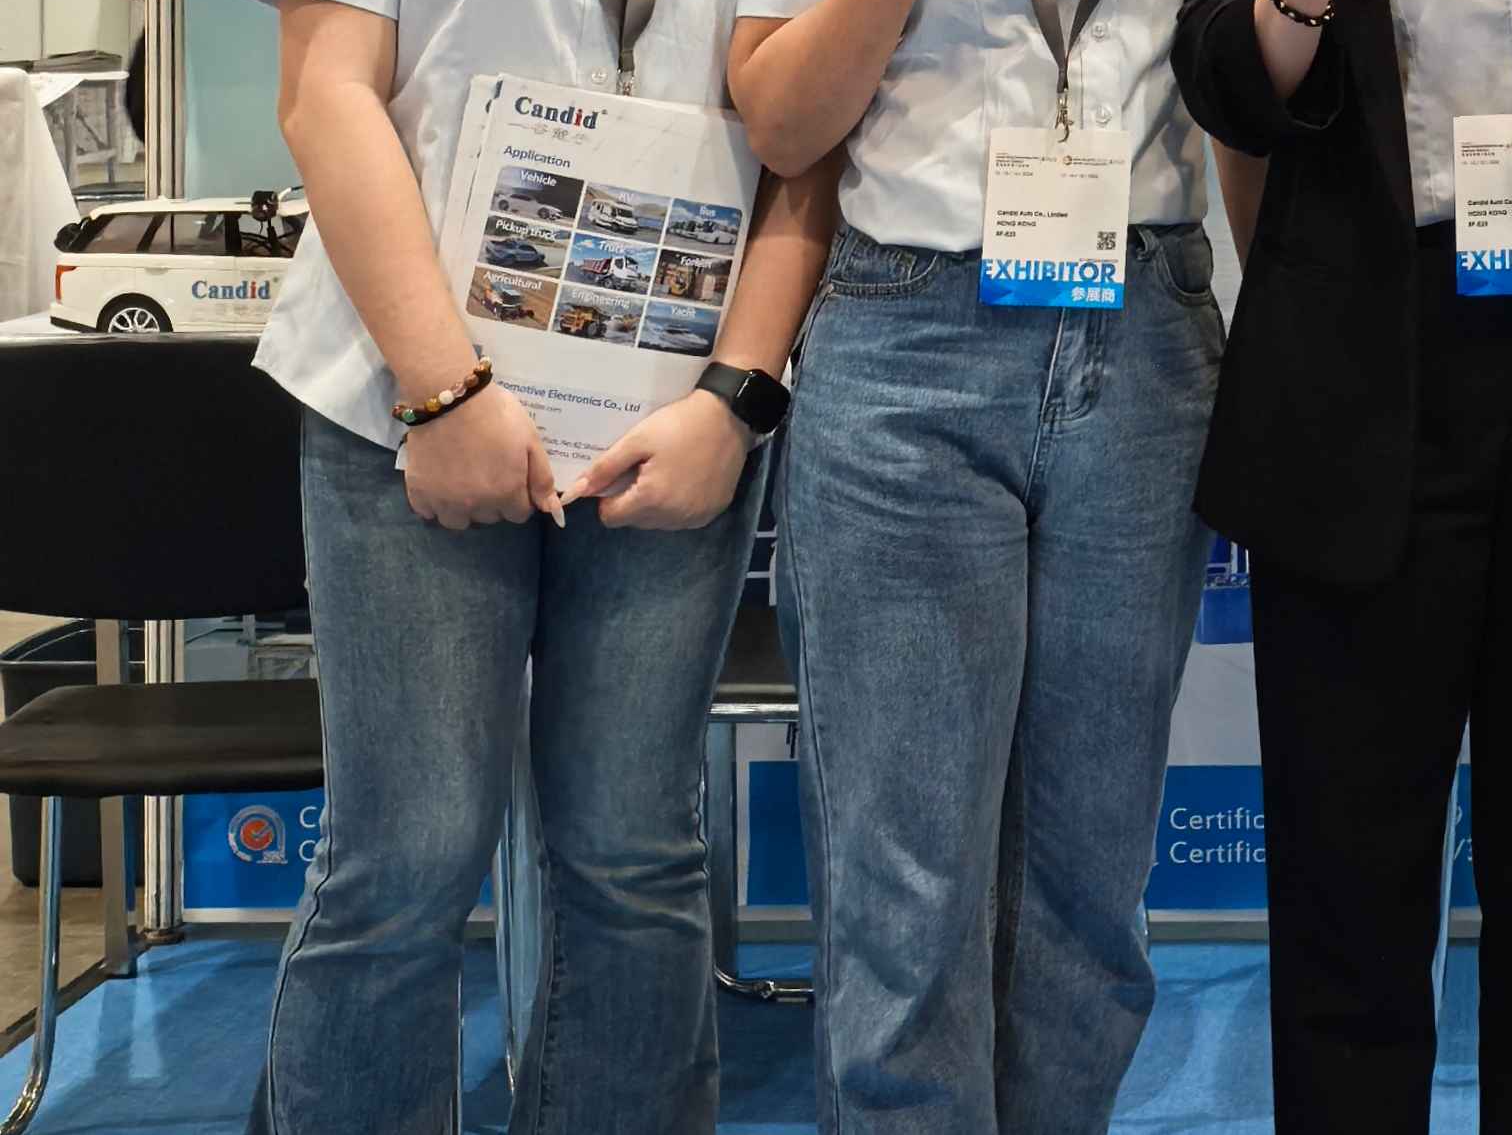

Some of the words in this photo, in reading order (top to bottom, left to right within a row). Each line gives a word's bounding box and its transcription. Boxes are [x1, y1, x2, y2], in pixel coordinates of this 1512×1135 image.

[514, 96, 598, 130] Candid
[503, 145, 571, 168] Application
[520, 170, 557, 187] Vehicle
[495, 220, 529, 238] Pickup
[530, 225, 558, 242] truck
[483, 271, 543, 291] Agricultural
[982, 258, 1116, 284] EXHIBITOR
[192, 280, 271, 300] Candid
[548, 388, 602, 407] Electronics
[624, 401, 641, 413] Ltd
